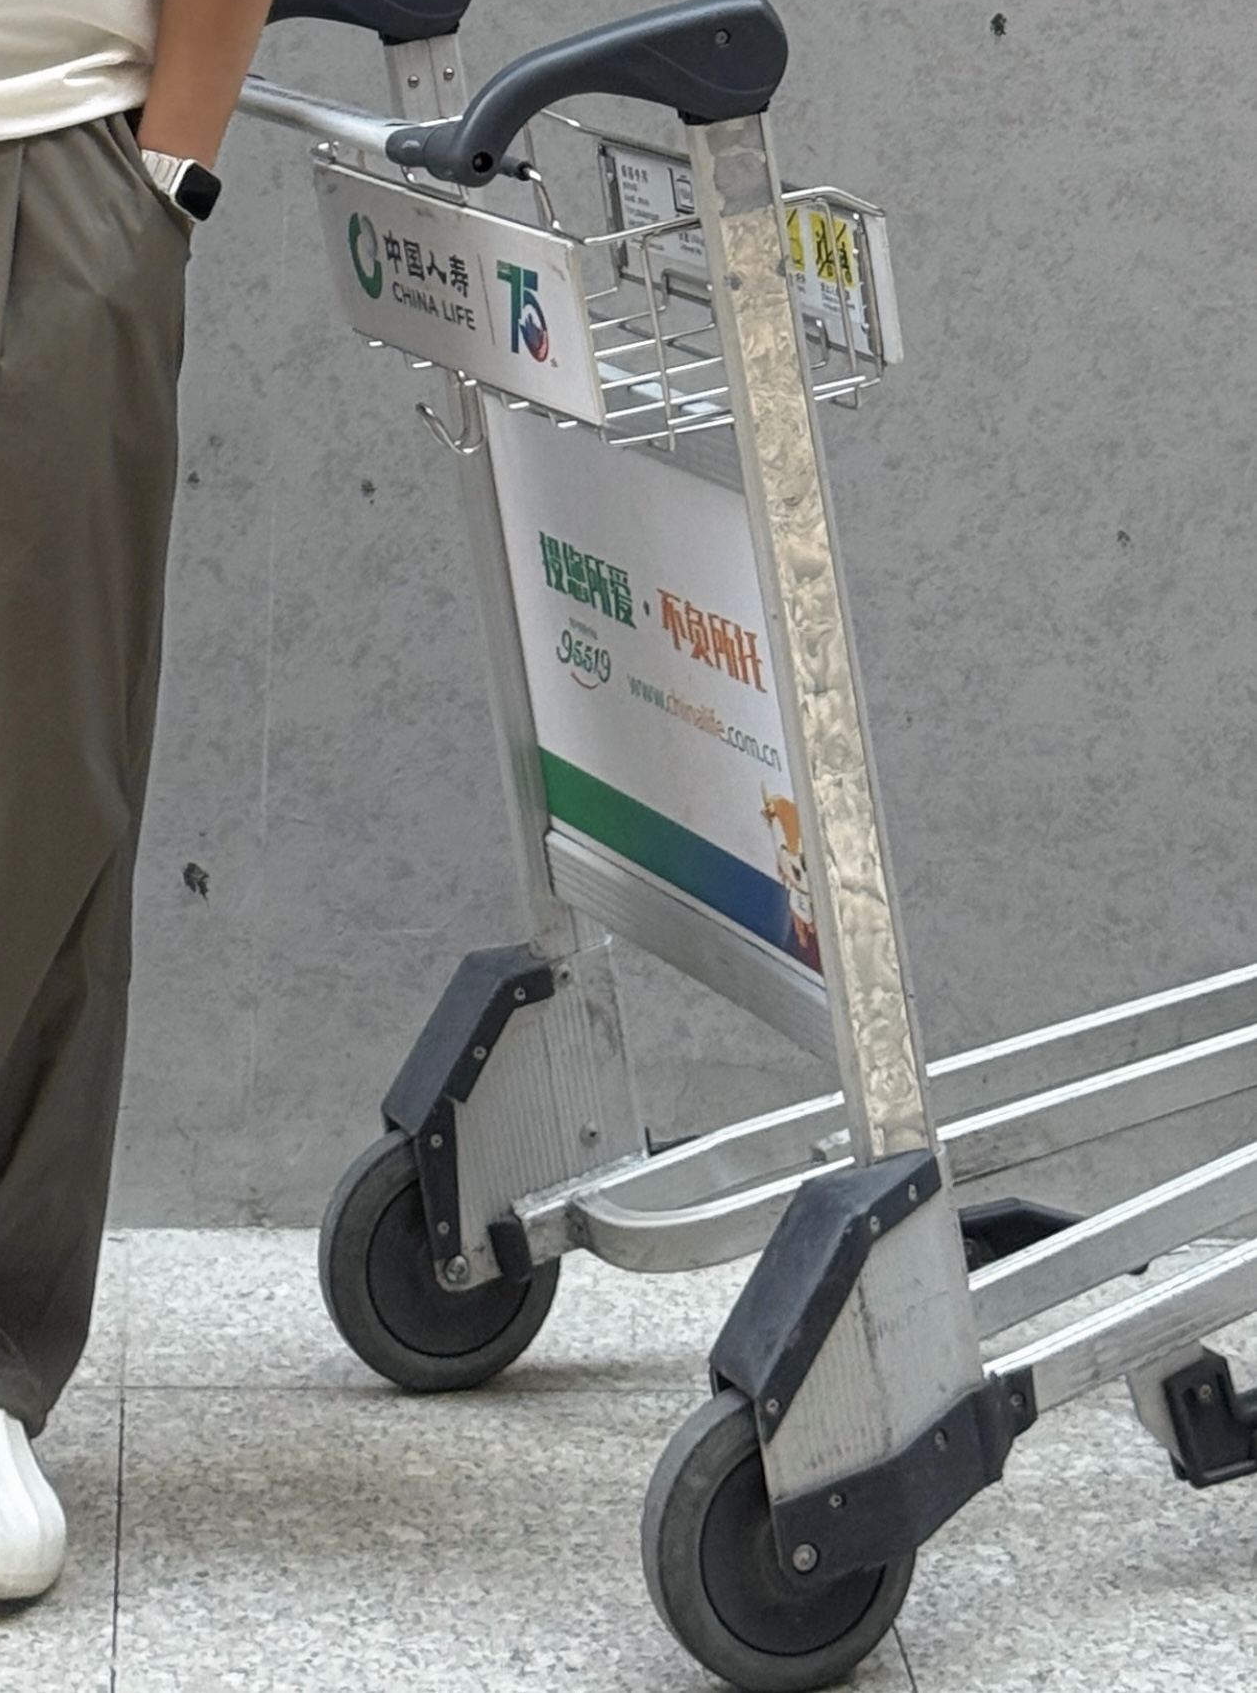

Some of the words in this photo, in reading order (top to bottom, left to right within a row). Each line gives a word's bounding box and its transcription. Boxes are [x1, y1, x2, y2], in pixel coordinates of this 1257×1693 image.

[383, 229, 469, 298] 中国人寿
[392, 281, 440, 317] CHINA
[442, 300, 477, 331] LIFE
[556, 629, 612, 683] 95519
[626, 673, 783, 773] www.ce.com.cn
